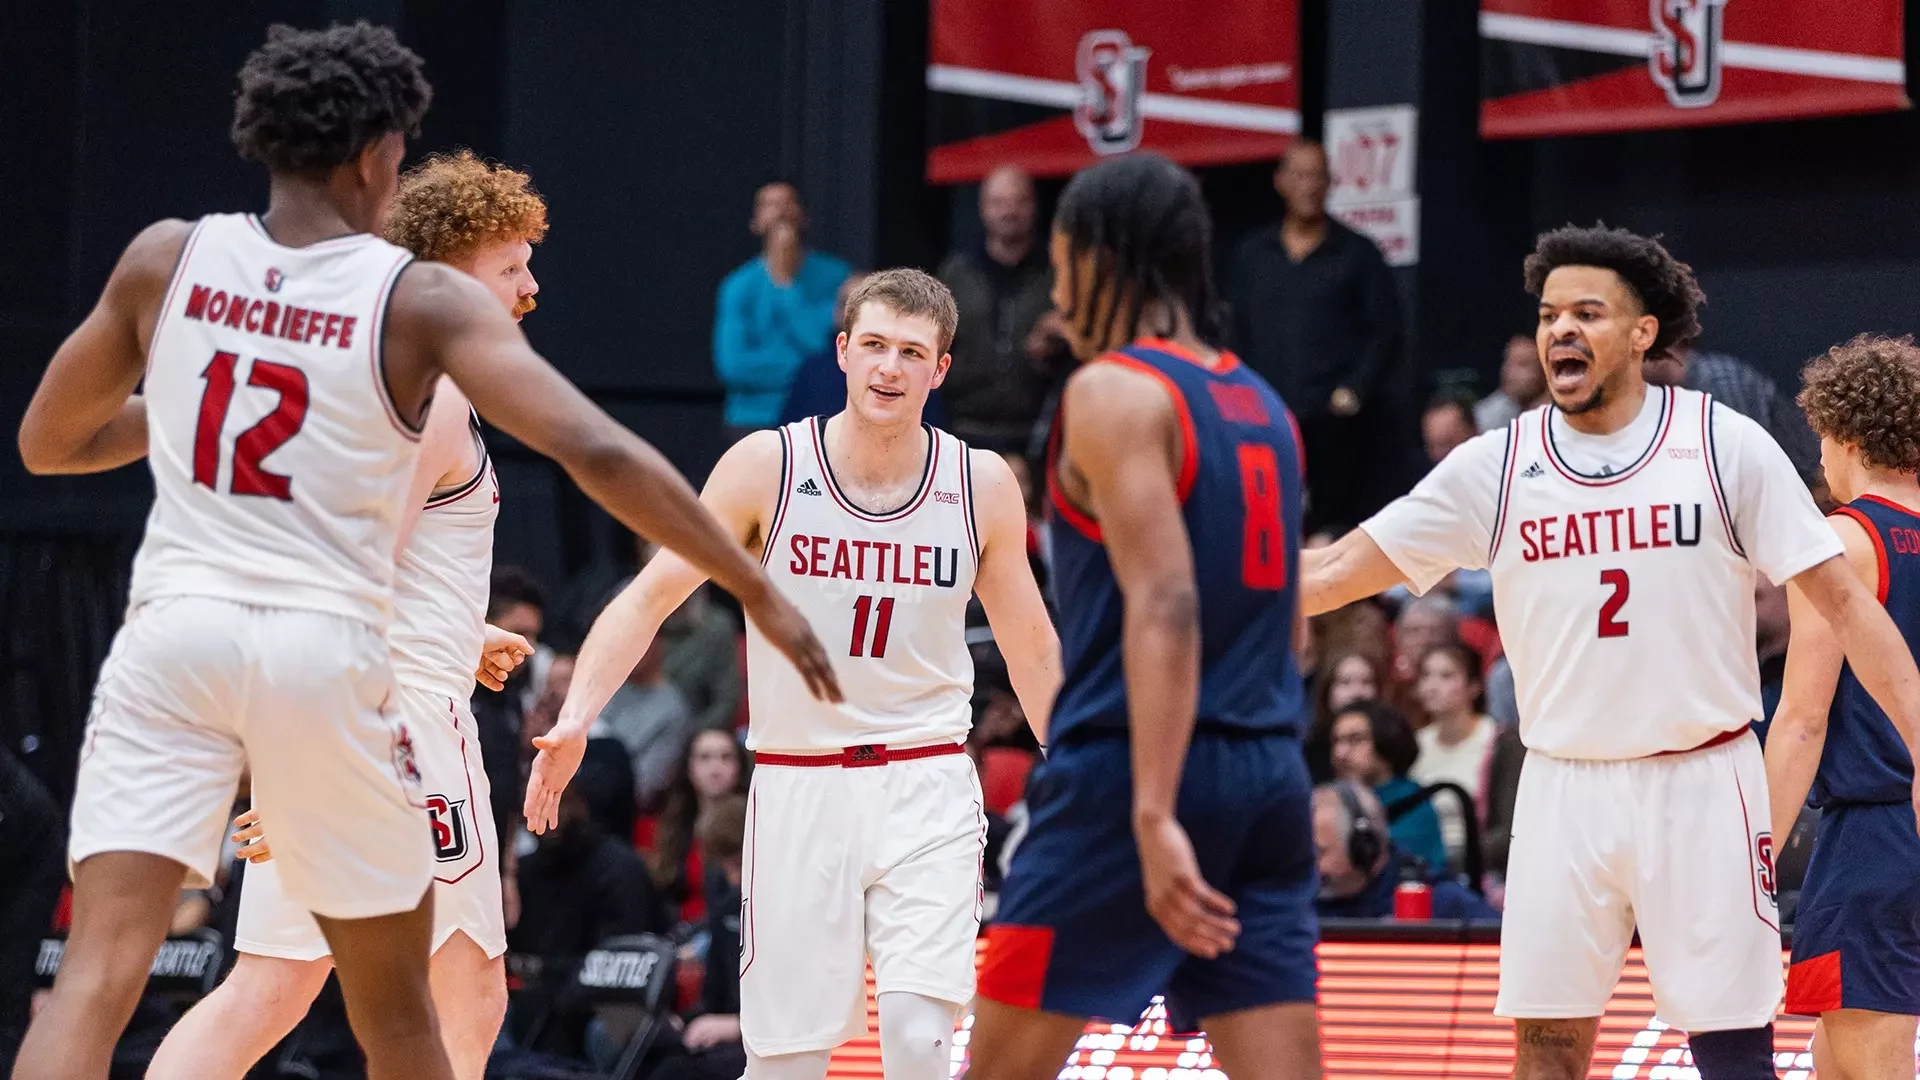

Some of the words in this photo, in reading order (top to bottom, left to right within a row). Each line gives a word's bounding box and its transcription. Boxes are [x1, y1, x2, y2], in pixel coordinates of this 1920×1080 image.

[184, 283, 358, 350] MONCRIEFFE
[192, 349, 311, 501] 12
[796, 486, 822, 497] adidas
[933, 490, 959, 504] WAC
[1236, 442, 1288, 590] 8
[849, 595, 895, 659] 11
[1598, 568, 1630, 638] 2
